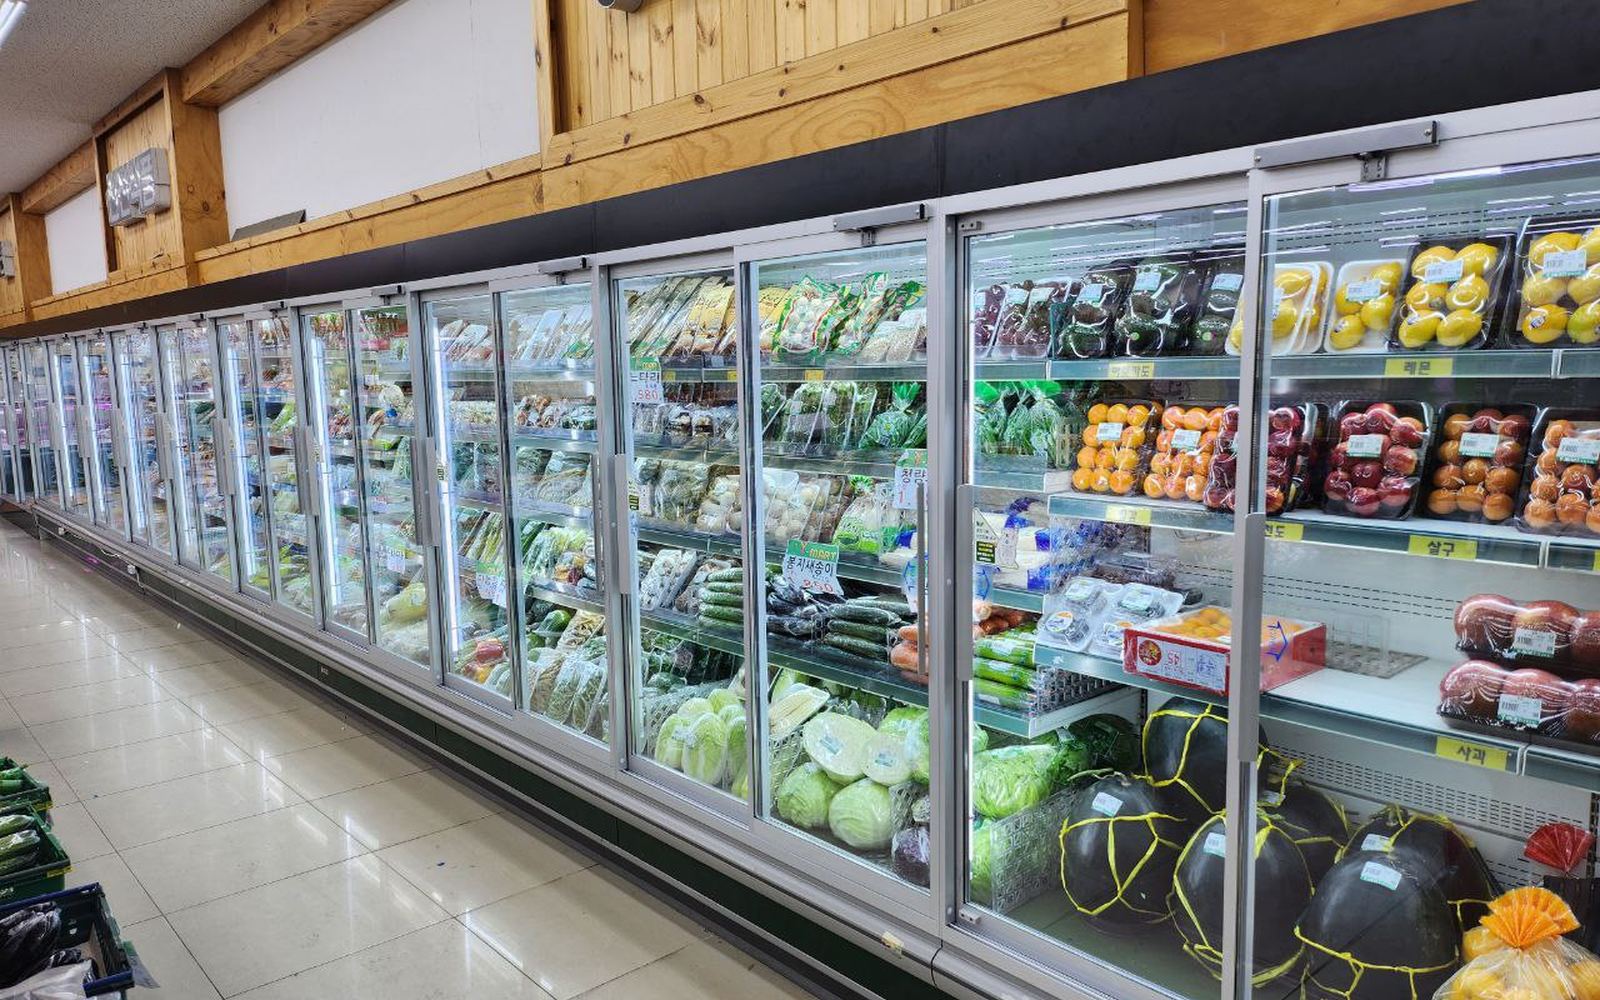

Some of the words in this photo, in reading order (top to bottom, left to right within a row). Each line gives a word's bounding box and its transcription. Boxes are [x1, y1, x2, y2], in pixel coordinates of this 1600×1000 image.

[1403, 360, 1431, 376] 레몬
[1427, 540, 1455, 557] 살구
[786, 555, 834, 577] 봉지새송이
[1456, 745, 1487, 766] 사과
